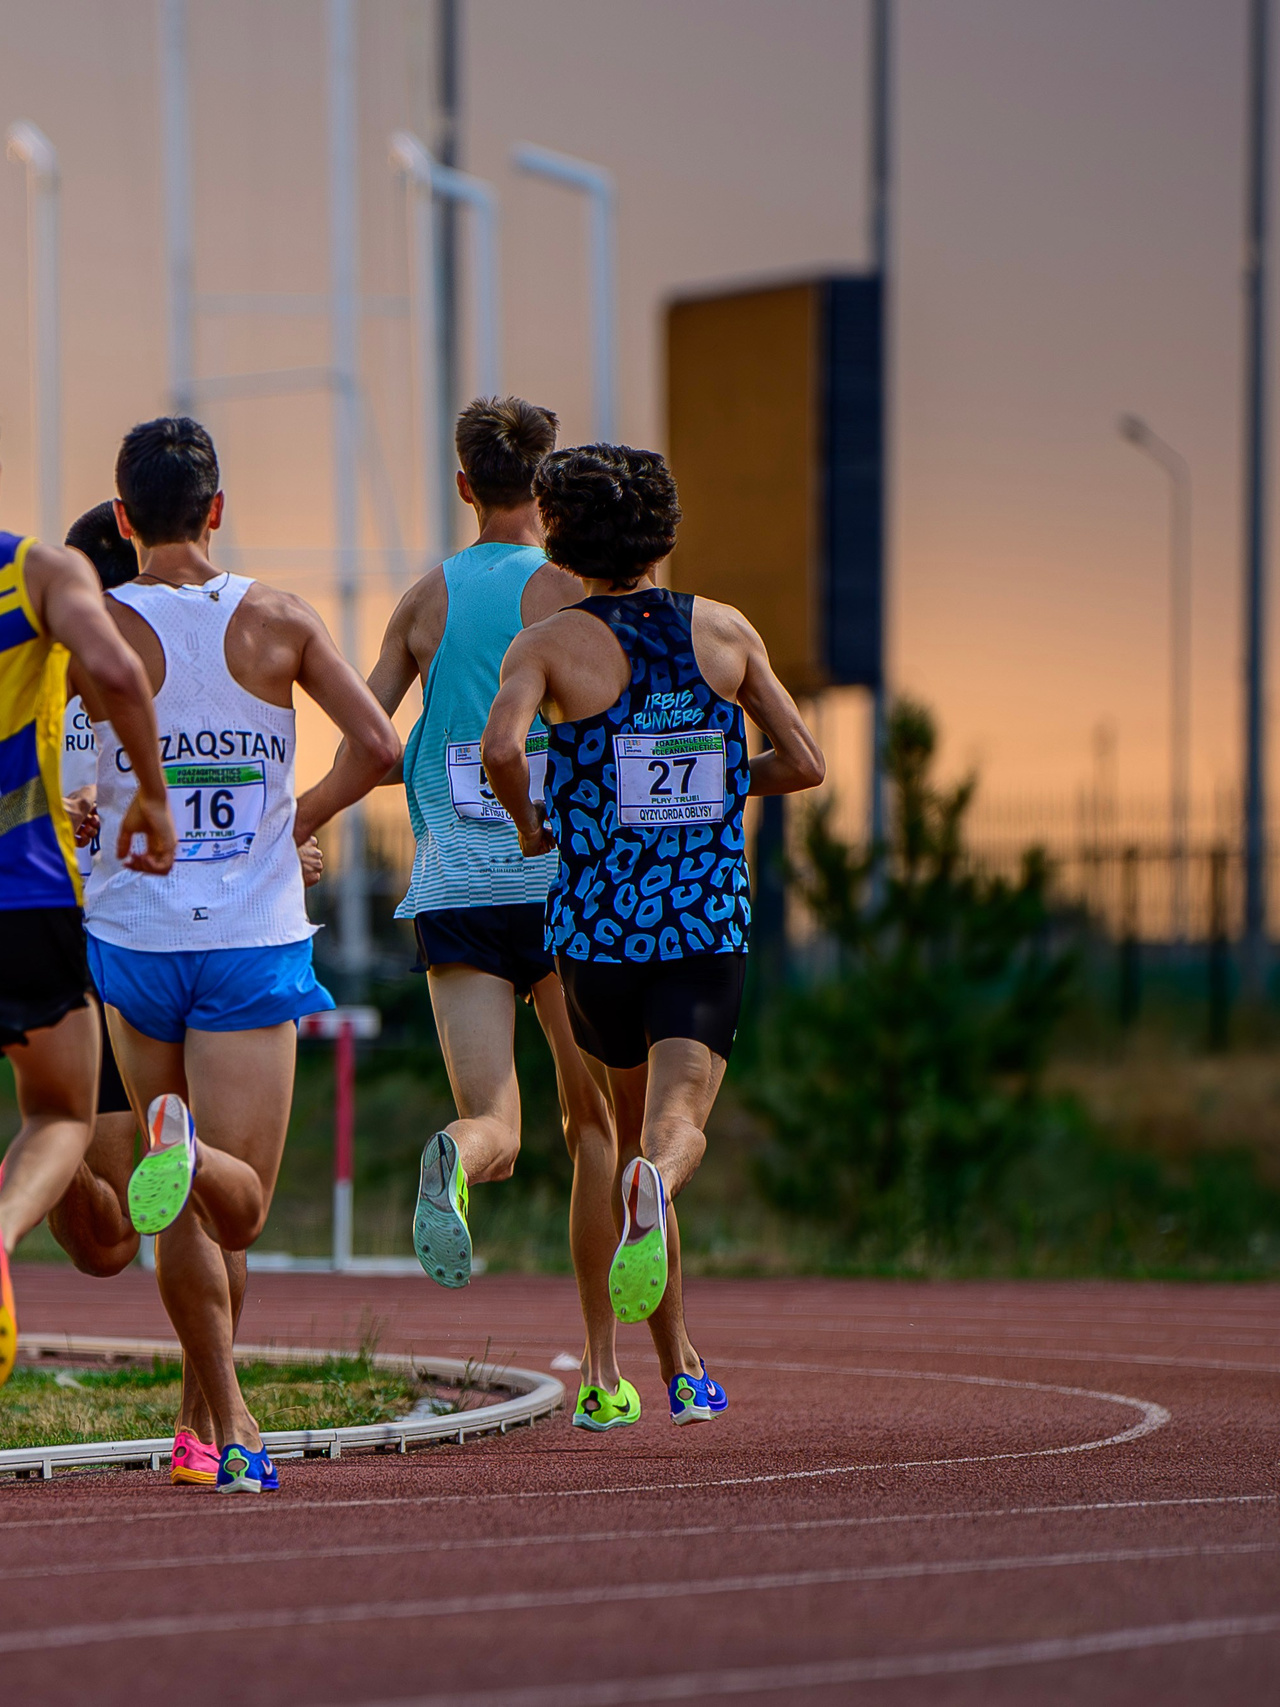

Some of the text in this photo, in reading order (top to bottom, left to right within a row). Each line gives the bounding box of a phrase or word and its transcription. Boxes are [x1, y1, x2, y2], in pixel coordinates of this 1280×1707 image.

[645, 690, 694, 709] IRBIS
[633, 708, 705, 729] RUNNERS
[648, 757, 698, 795] 27
[185, 789, 235, 830] 16
[640, 805, 712, 820] QYZYLORDA OBLYSY
